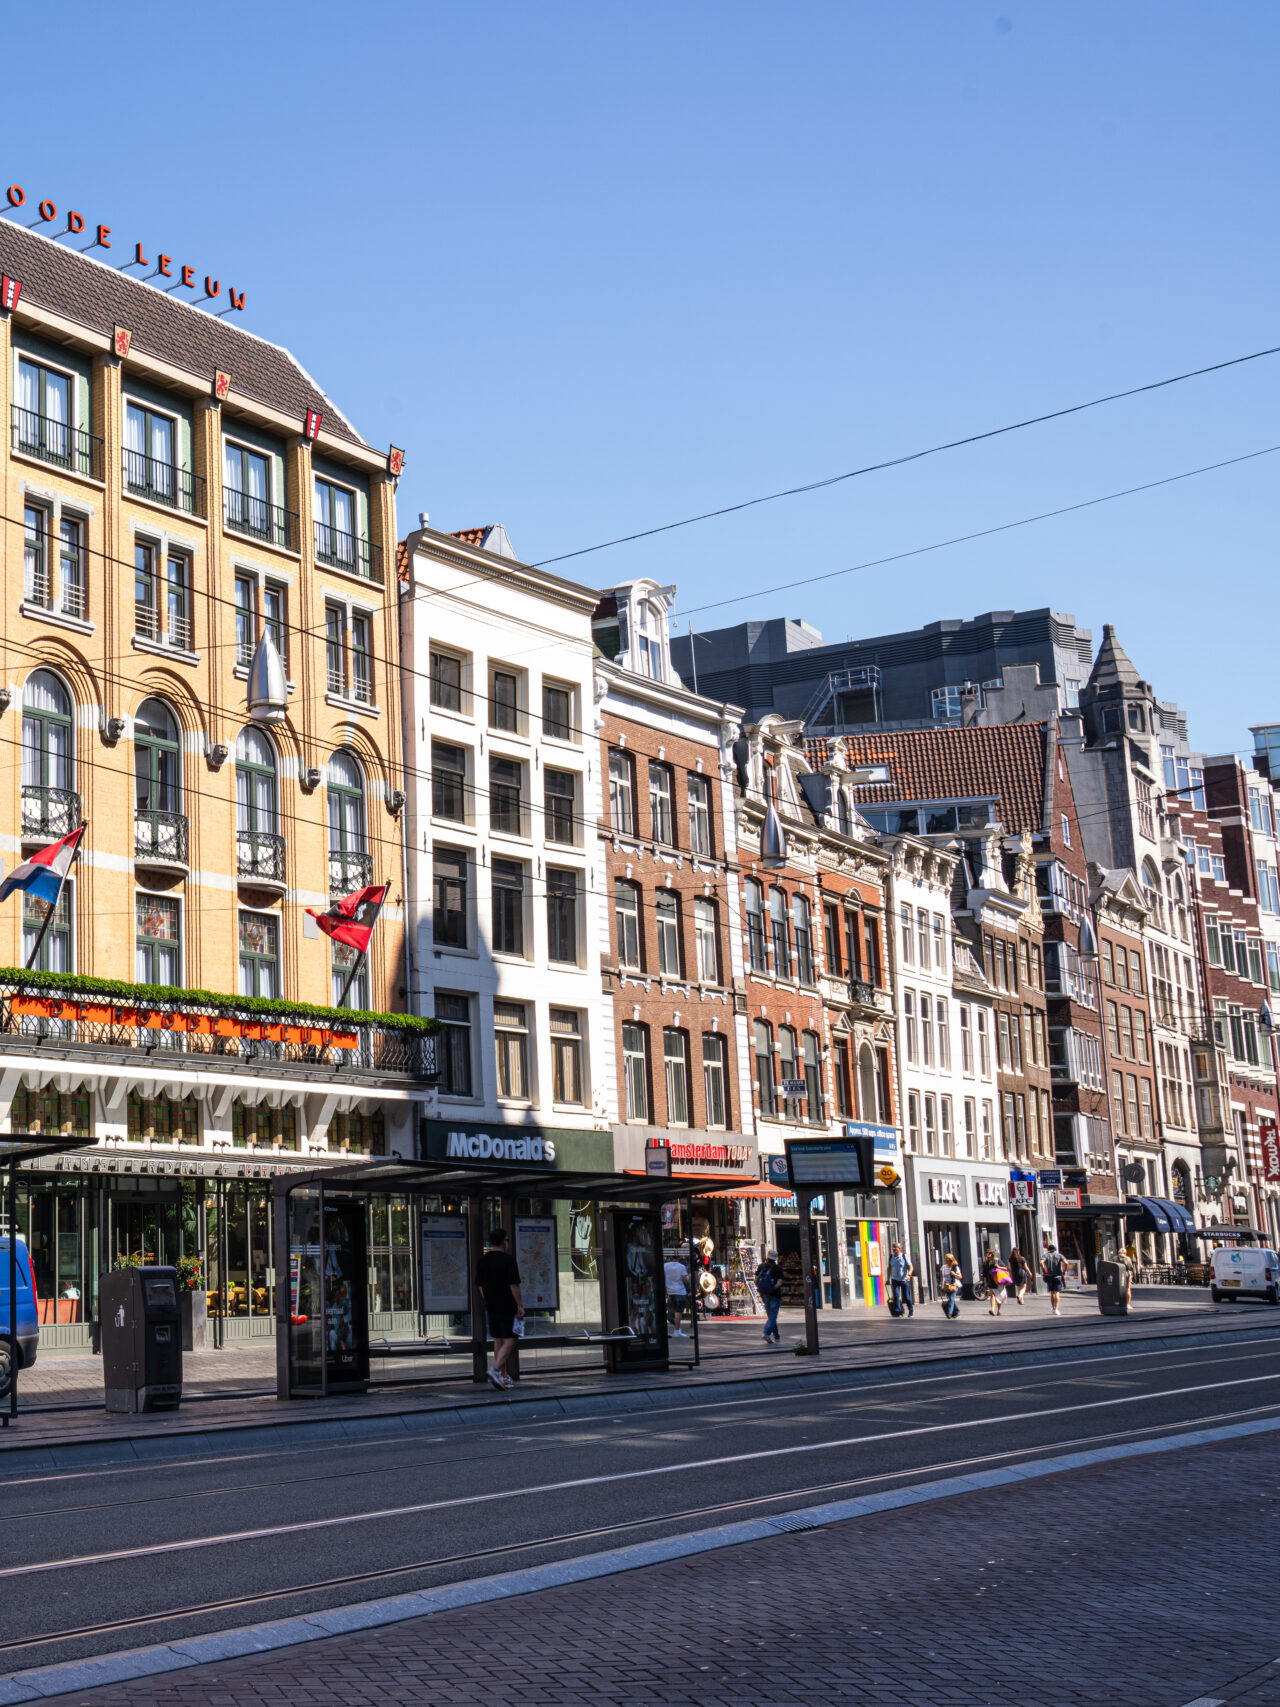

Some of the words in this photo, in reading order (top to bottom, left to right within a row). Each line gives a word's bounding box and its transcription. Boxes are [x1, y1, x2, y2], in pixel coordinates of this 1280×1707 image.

[135, 243, 246, 310] LEEUW
[51, 1000, 88, 1020] DE
[446, 1132, 555, 1161] McDonald's
[941, 1179, 962, 1202] KFC
[988, 1182, 1006, 1203] KFC
